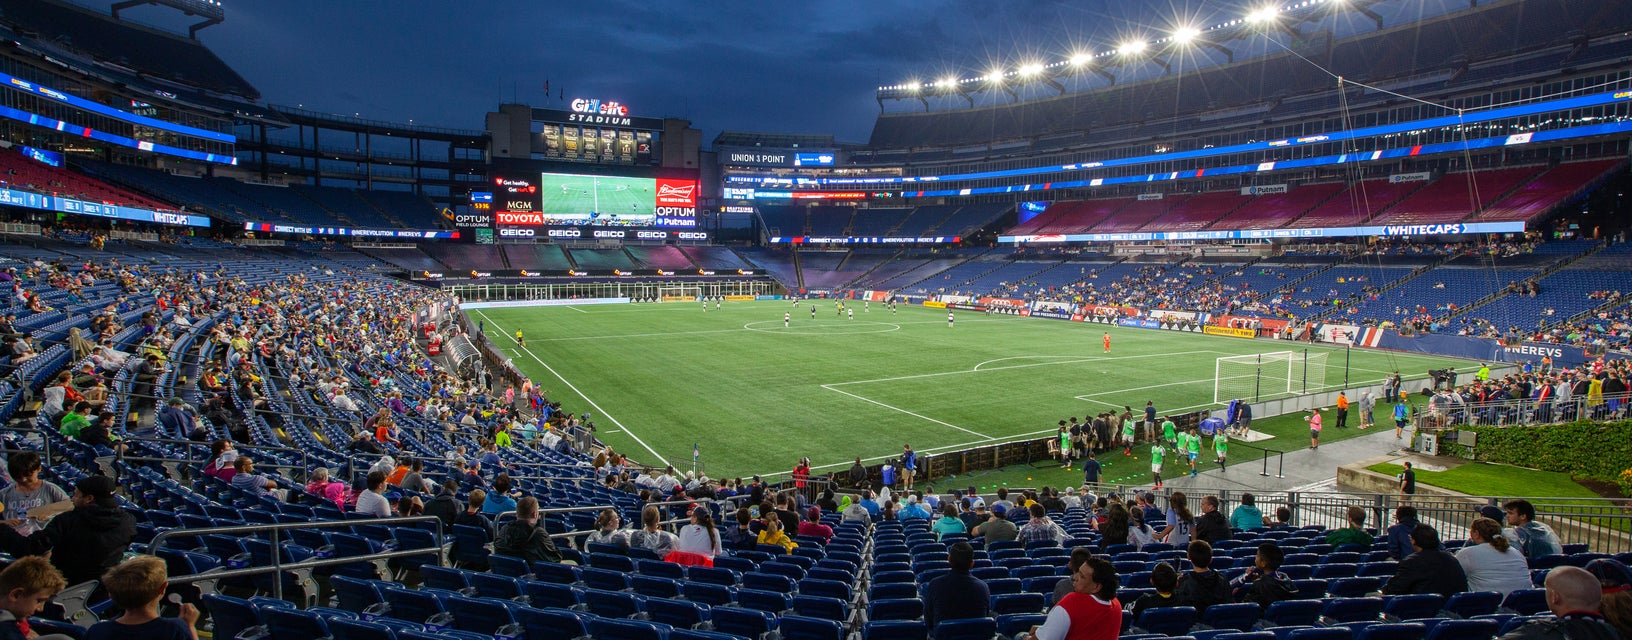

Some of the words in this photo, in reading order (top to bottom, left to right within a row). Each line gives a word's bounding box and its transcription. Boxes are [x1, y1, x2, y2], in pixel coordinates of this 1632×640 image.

[571, 98, 628, 116] Gillette
[569, 113, 631, 125] STADIUM
[731, 153, 755, 162] UNION
[762, 155, 785, 163] POINT
[660, 186, 690, 194] Budweiser
[1257, 186, 1284, 194] Putnam
[507, 200, 532, 209] MGM
[657, 206, 696, 217] OPTUM
[154, 211, 188, 225] WHITECAPS
[455, 215, 490, 223] OPTUM
[498, 213, 542, 223] TOYOTA
[664, 218, 696, 226] Putnam
[548, 229, 581, 237] GEICO
[1387, 223, 1461, 235] WHITECAPS
[593, 230, 625, 238] GEICO
[1205, 326, 1235, 335] Continental
[1178, 522, 1189, 536] 13
